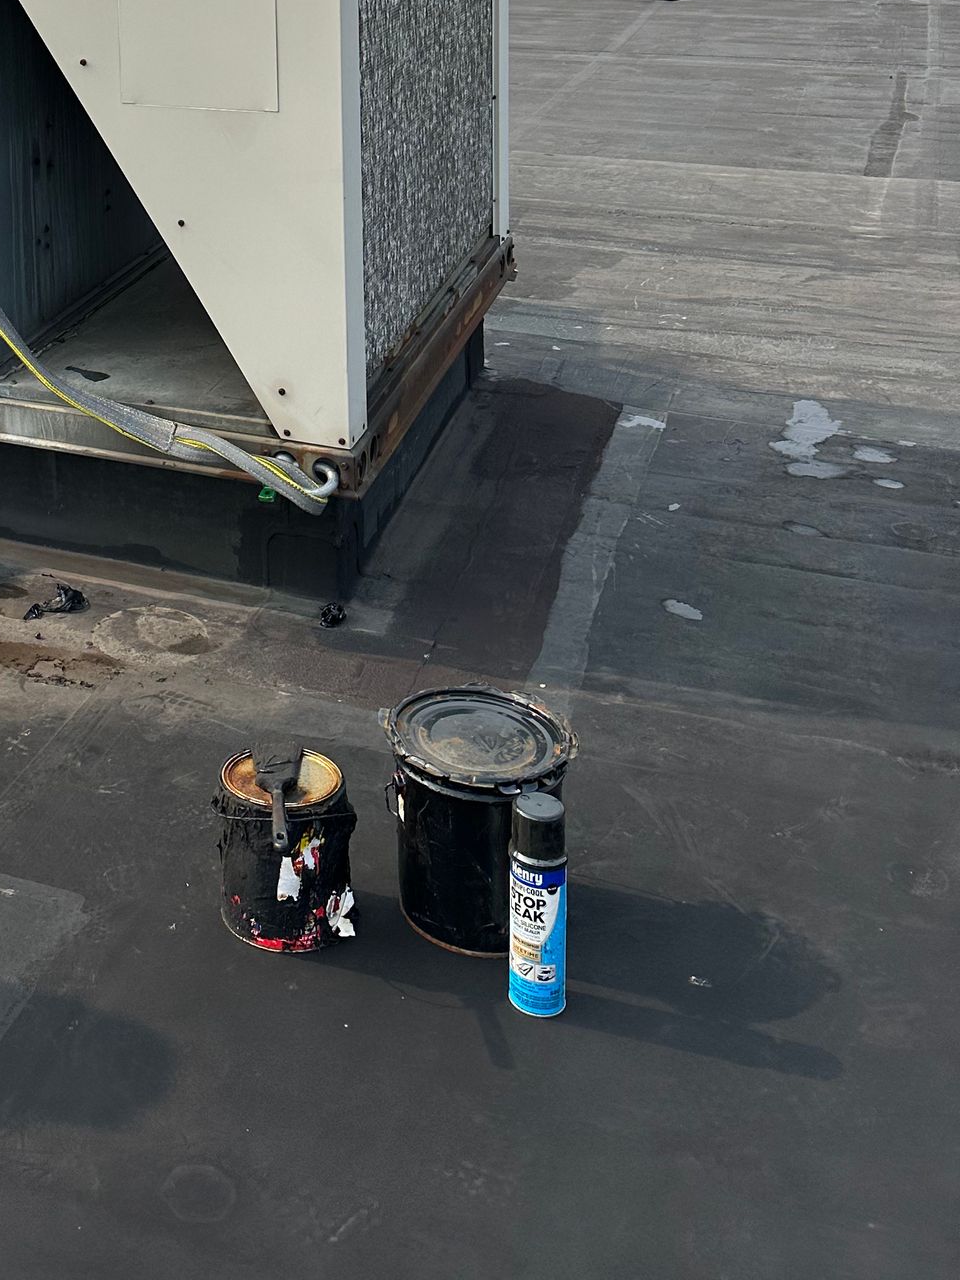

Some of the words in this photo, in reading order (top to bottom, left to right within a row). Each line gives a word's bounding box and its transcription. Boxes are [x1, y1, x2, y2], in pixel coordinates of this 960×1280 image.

[511, 860, 543, 886] Henry
[511, 886, 547, 911] STOP
[511, 897, 545, 925] LEAK
[520, 920, 547, 932] SILICONE
